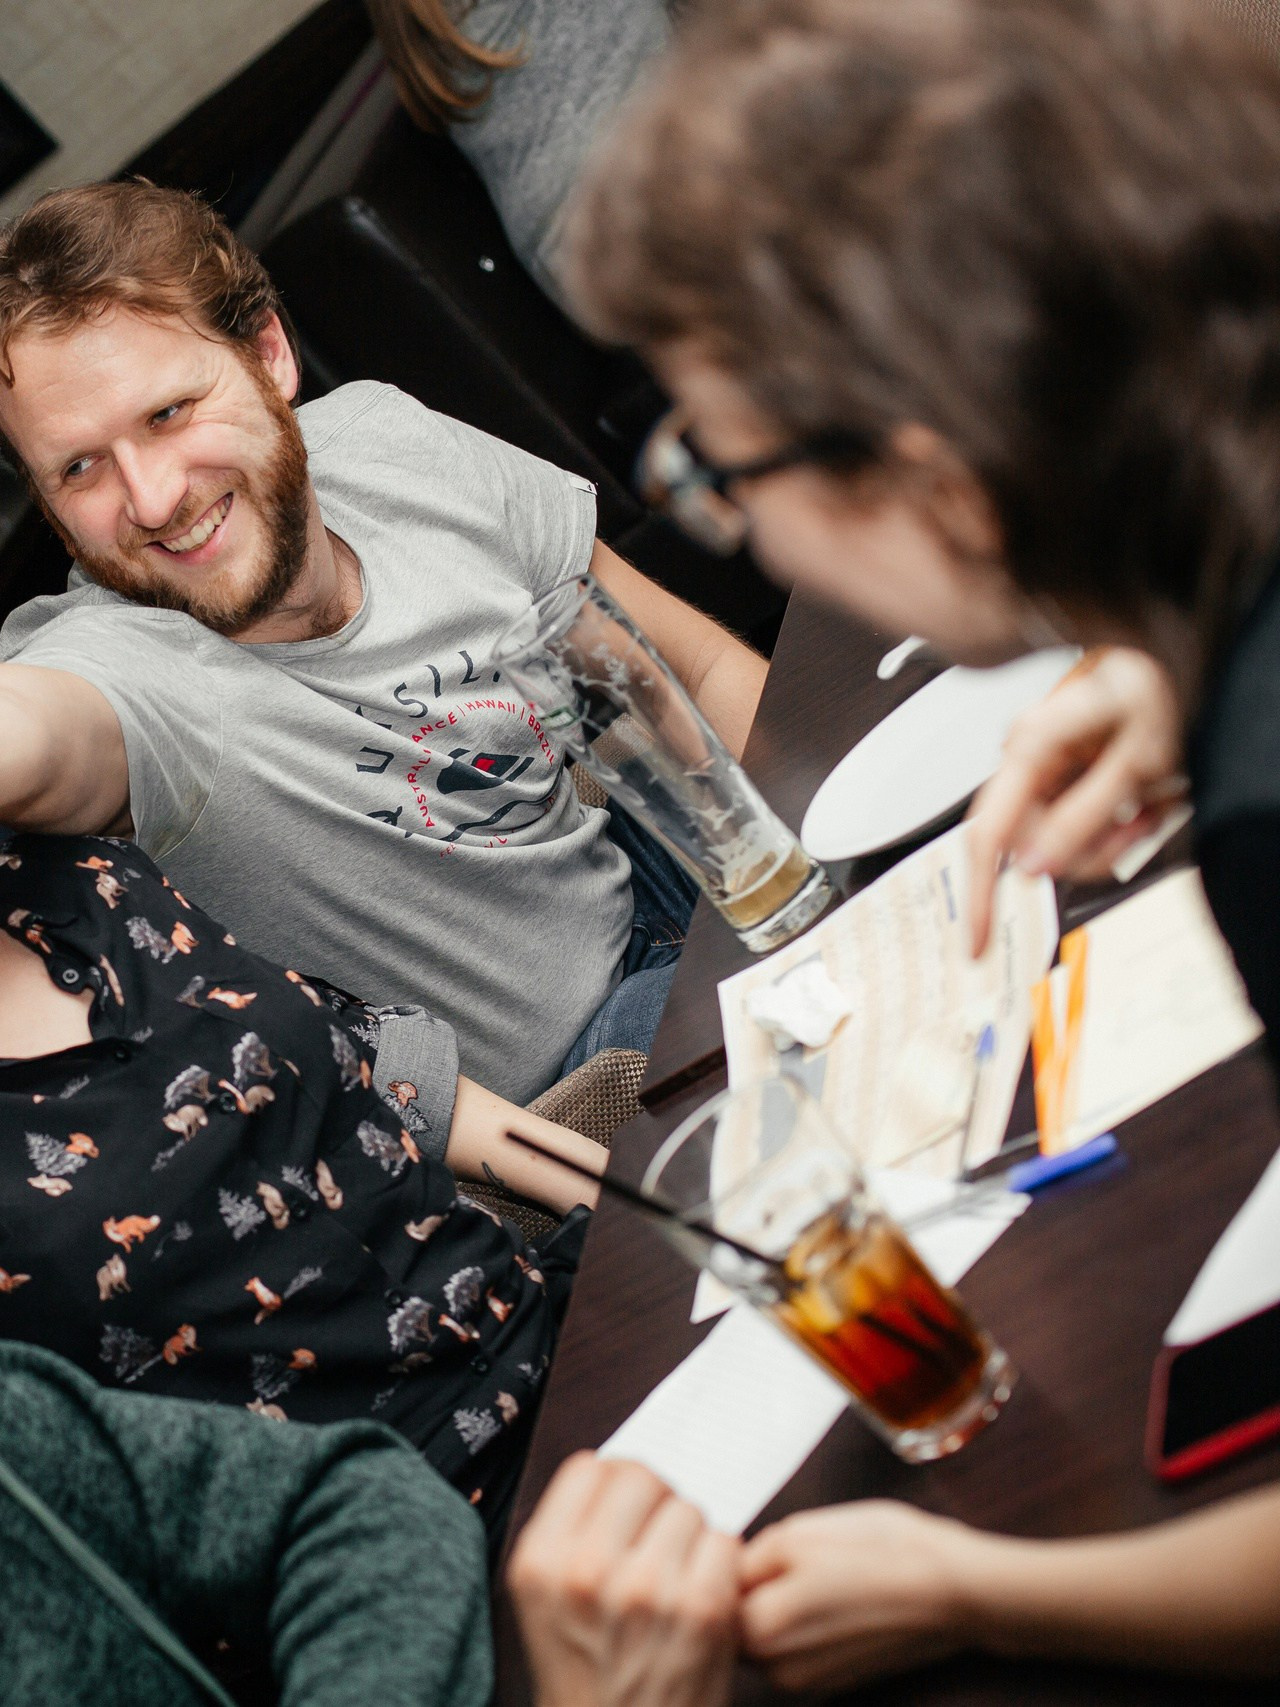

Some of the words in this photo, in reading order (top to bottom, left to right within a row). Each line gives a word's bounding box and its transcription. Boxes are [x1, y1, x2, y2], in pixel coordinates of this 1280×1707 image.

[407, 748, 435, 827] AUSTRALI
[464, 699, 516, 715] HAWAII
[527, 714, 555, 767] BRAZIL
